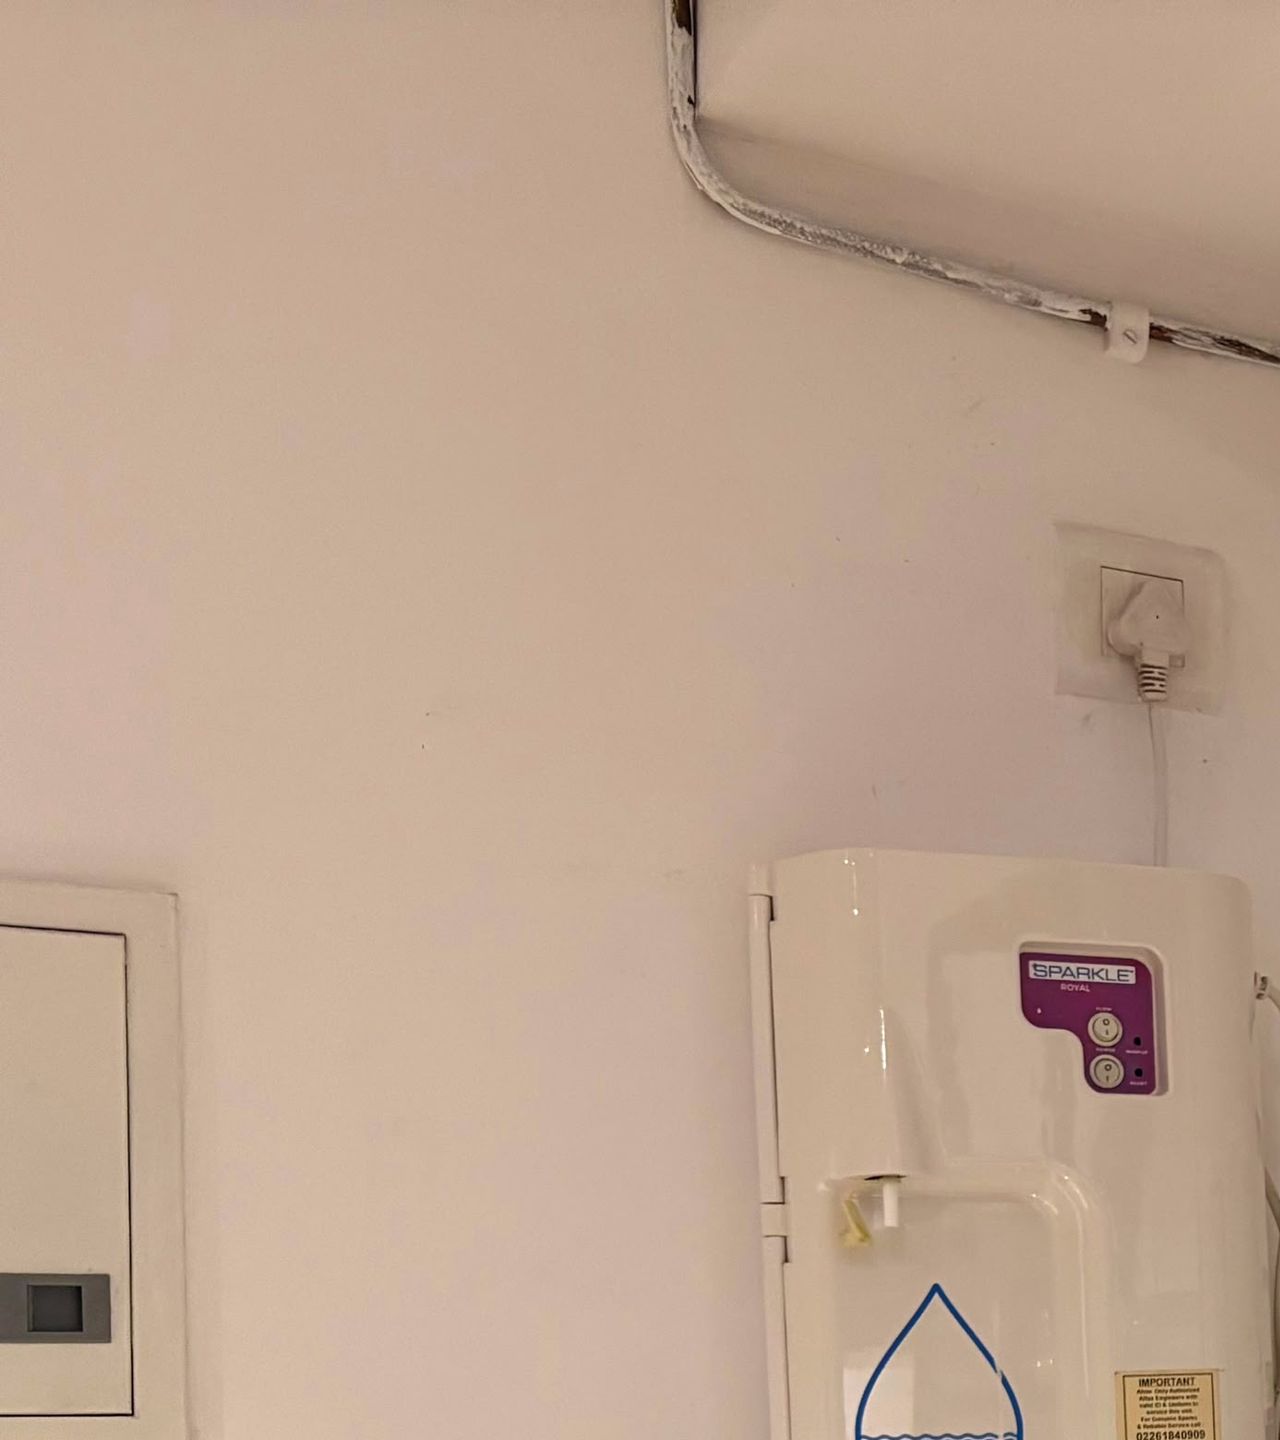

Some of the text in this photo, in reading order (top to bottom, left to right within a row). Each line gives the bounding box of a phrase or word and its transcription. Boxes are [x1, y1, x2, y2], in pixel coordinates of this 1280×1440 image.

[1031, 962, 1131, 982] SPARKLE
[1060, 983, 1090, 992] ROYAL
[1139, 1377, 1195, 1386] IMPORTANT
[1136, 1430, 1206, 1440] 02261840909
